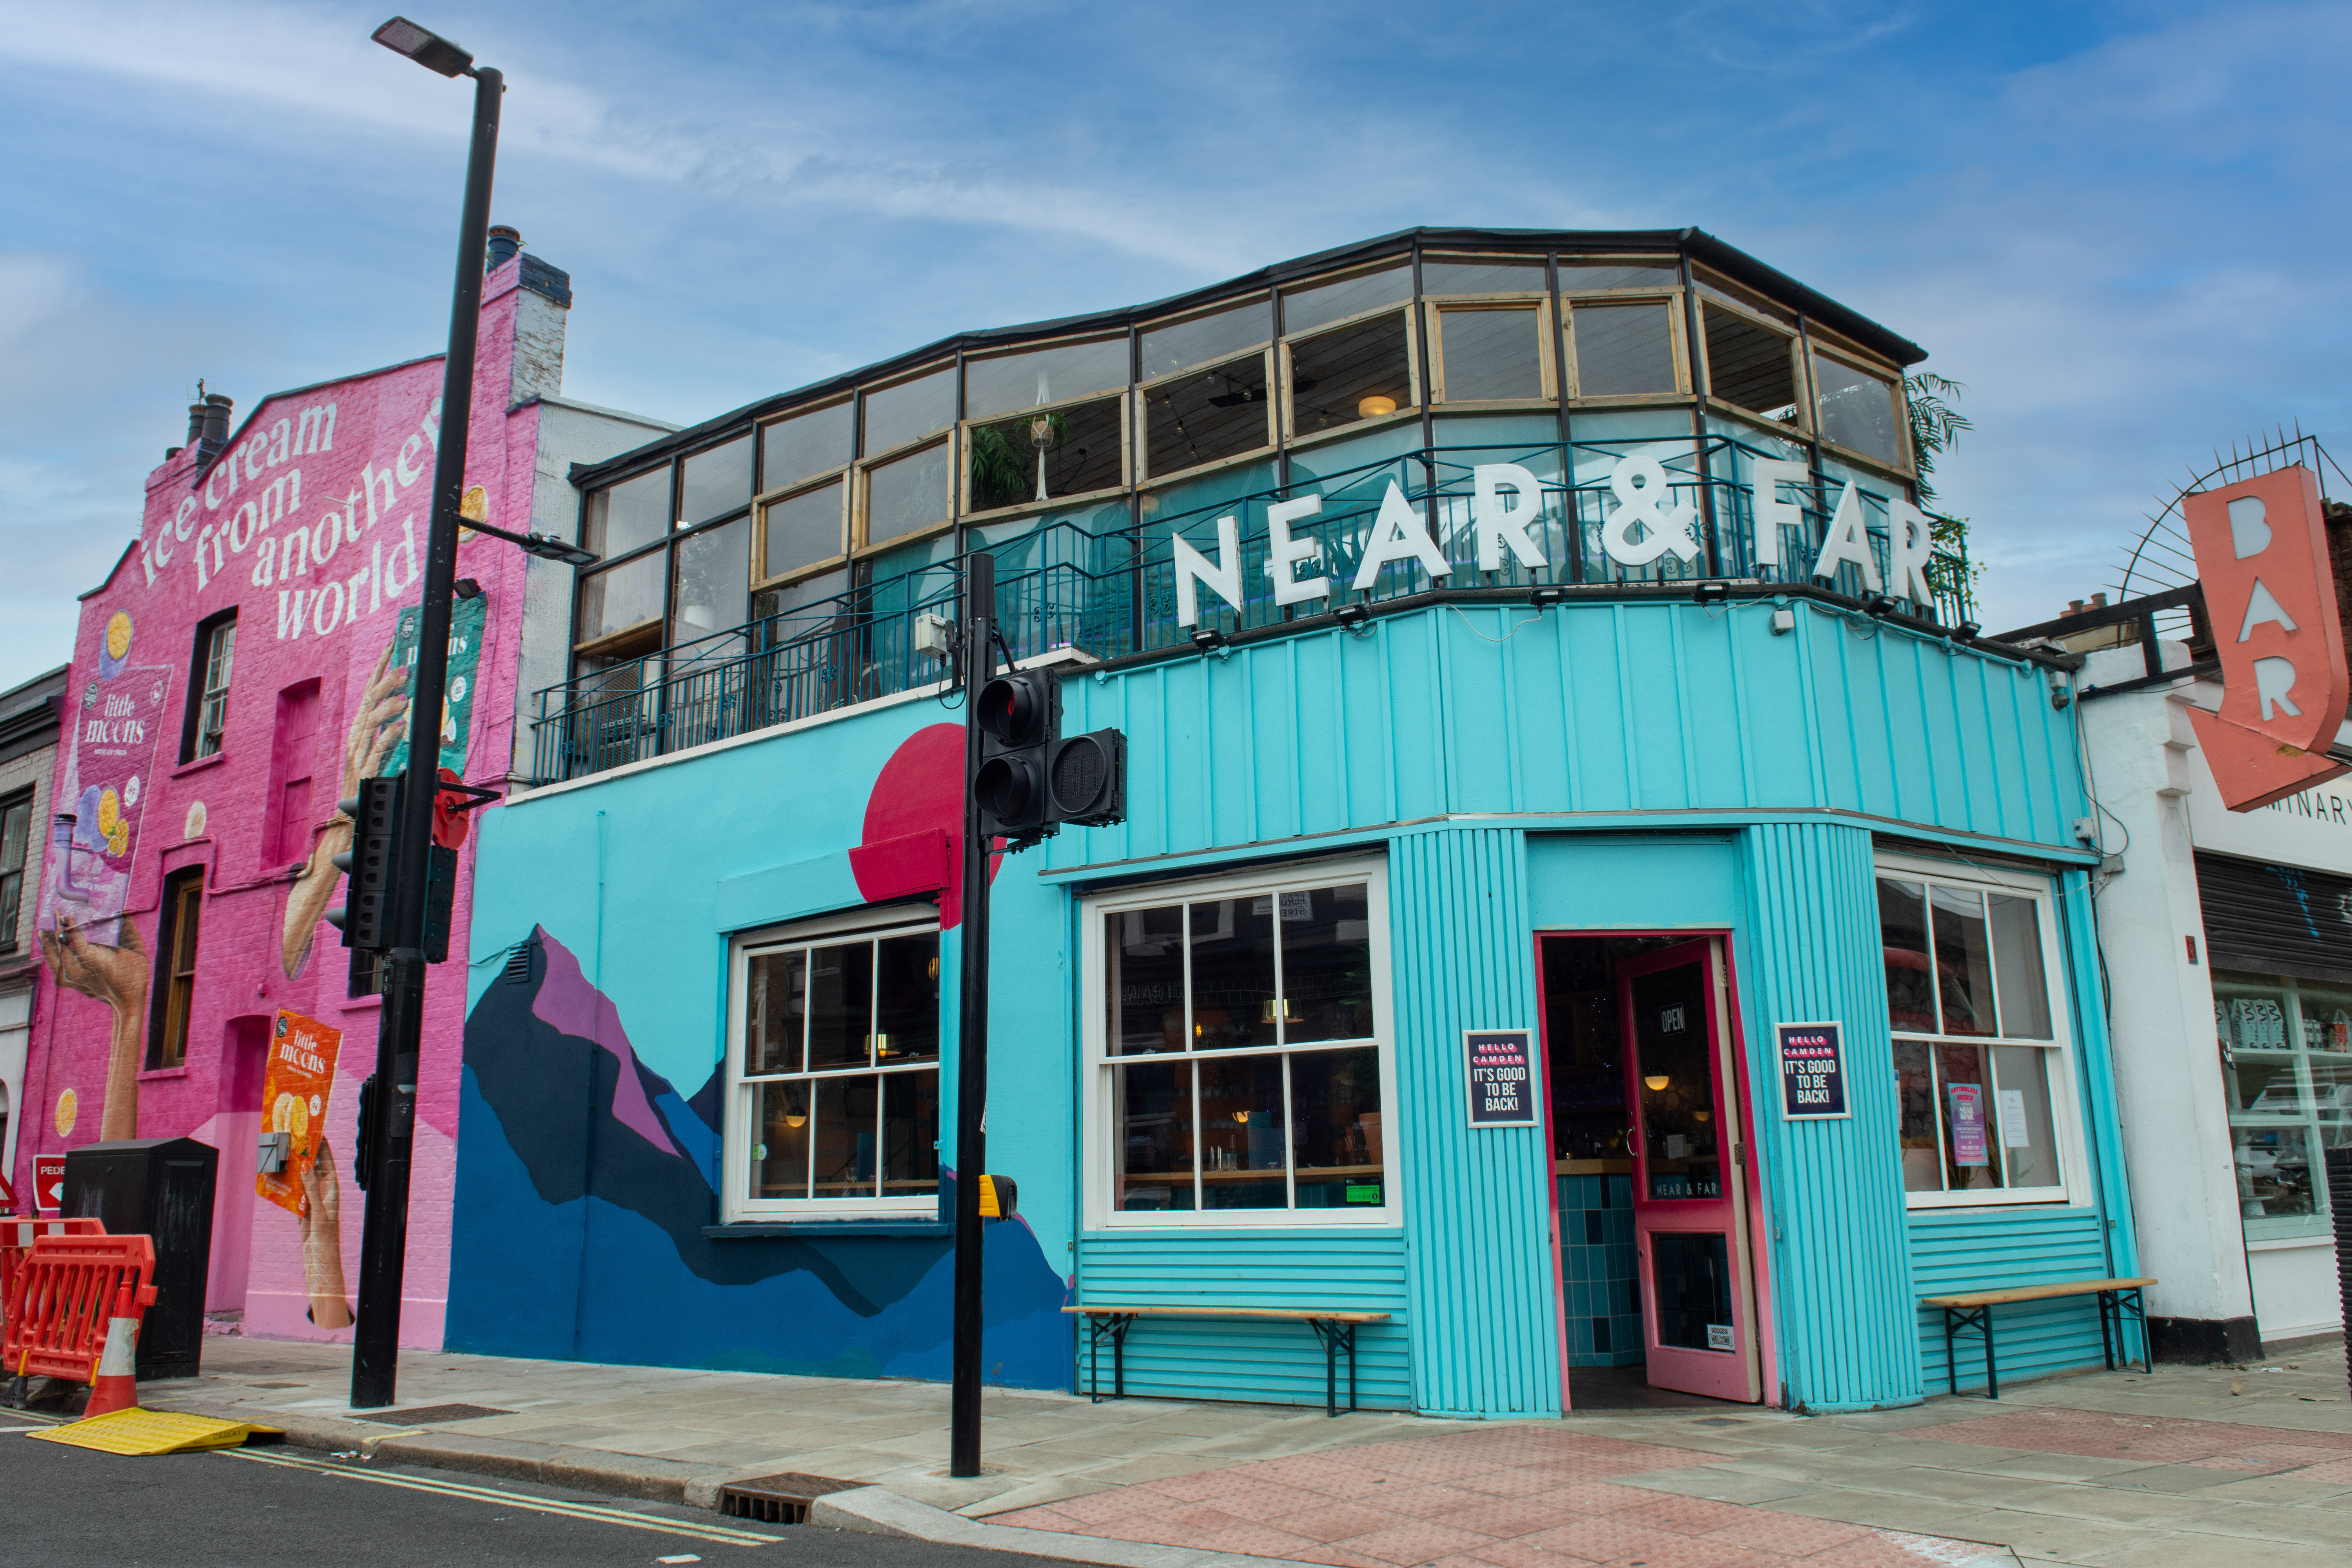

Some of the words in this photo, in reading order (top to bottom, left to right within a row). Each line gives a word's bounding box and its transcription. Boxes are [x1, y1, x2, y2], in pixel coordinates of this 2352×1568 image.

[141, 495, 196, 588] ice
[205, 403, 337, 510] cream
[252, 397, 442, 586] another
[193, 468, 301, 594] from
[1173, 463, 1547, 629] NEAR
[1601, 455, 1701, 567] &
[1753, 457, 1933, 609] FAR
[277, 513, 419, 639] world
[2226, 495, 2303, 721] BAR
[104, 694, 134, 717] little
[85, 720, 145, 744] moons
[1662, 1007, 1683, 1033] OPEN
[294, 1029, 317, 1052] little
[1789, 1036, 1827, 1046] HELLO
[1478, 1043, 1517, 1053] HELLO
[1784, 1048, 1835, 1058] CAMDEN
[280, 1043, 325, 1074] moons
[1473, 1055, 1524, 1065] CAMDEN
[1784, 1060, 1805, 1074] IT'S
[1807, 1060, 1836, 1073] GOOD
[1474, 1068, 1494, 1082] IT'S
[1497, 1067, 1526, 1081] GOOD
[1796, 1075, 1811, 1088] TO
[1813, 1075, 1828, 1088] BE
[1485, 1083, 1499, 1096] TO
[1502, 1082, 1516, 1096] BE
[1950, 1086, 1978, 1095] BOTTOMLESS
[1797, 1090, 1829, 1103] BACK!
[1485, 1097, 1519, 1111] BACK!
[41, 1166, 65, 1175] PEDE
[1657, 1183, 1681, 1195] NEAR
[1686, 1183, 1693, 1195] &
[1697, 1182, 1717, 1194] FAR
[1711, 1336, 1731, 1344] WELCOME
[213, 1429, 241, 1440] CADENT
